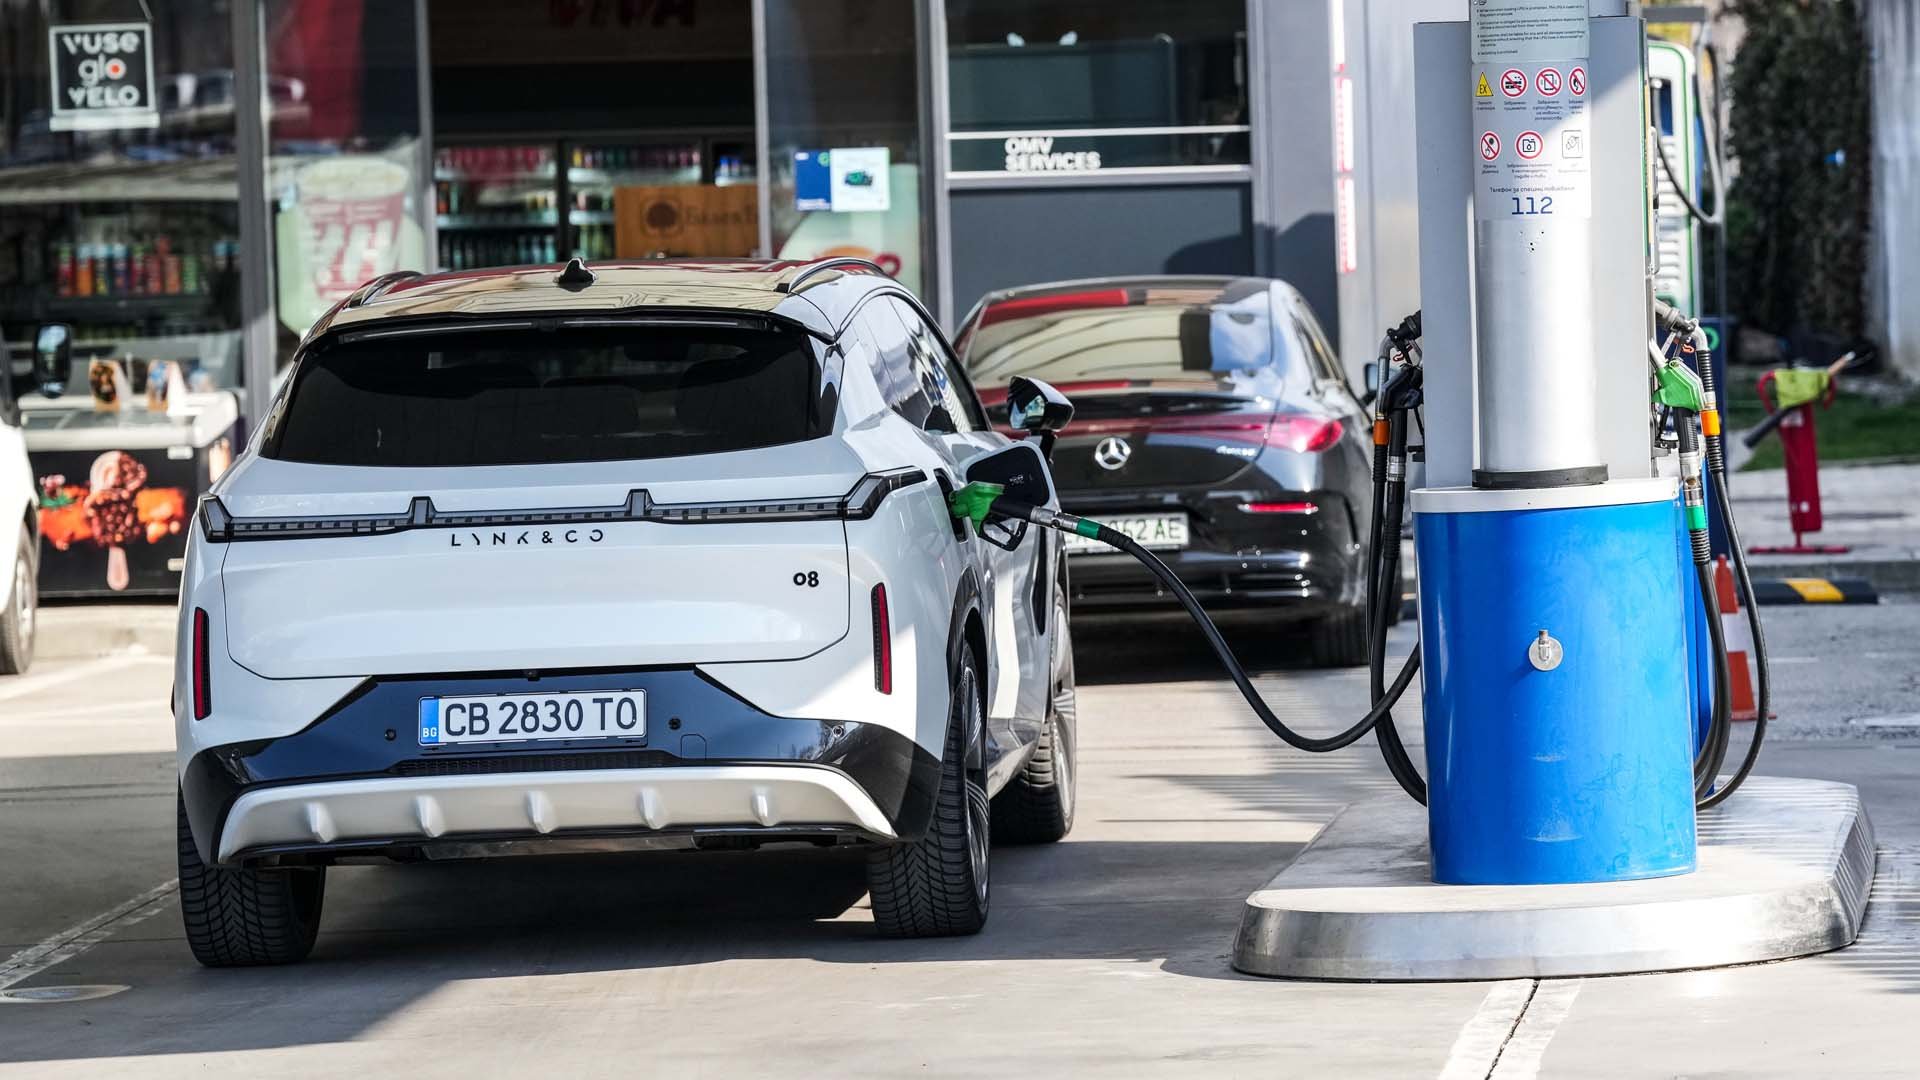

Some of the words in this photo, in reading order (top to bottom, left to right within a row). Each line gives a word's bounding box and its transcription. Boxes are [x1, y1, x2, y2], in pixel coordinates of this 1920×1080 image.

[79, 53, 126, 87] glo
[68, 85, 139, 106] VELO
[1479, 85, 1488, 94] EX
[1004, 137, 1054, 153] OMV
[1005, 152, 1101, 171] SERVICES
[1512, 196, 1552, 214] 112
[1154, 517, 1181, 539] AE
[793, 571, 819, 587] 08
[445, 702, 490, 737] CB
[499, 699, 584, 734] 2830
[592, 697, 638, 731] TO
[422, 727, 437, 738] BG
